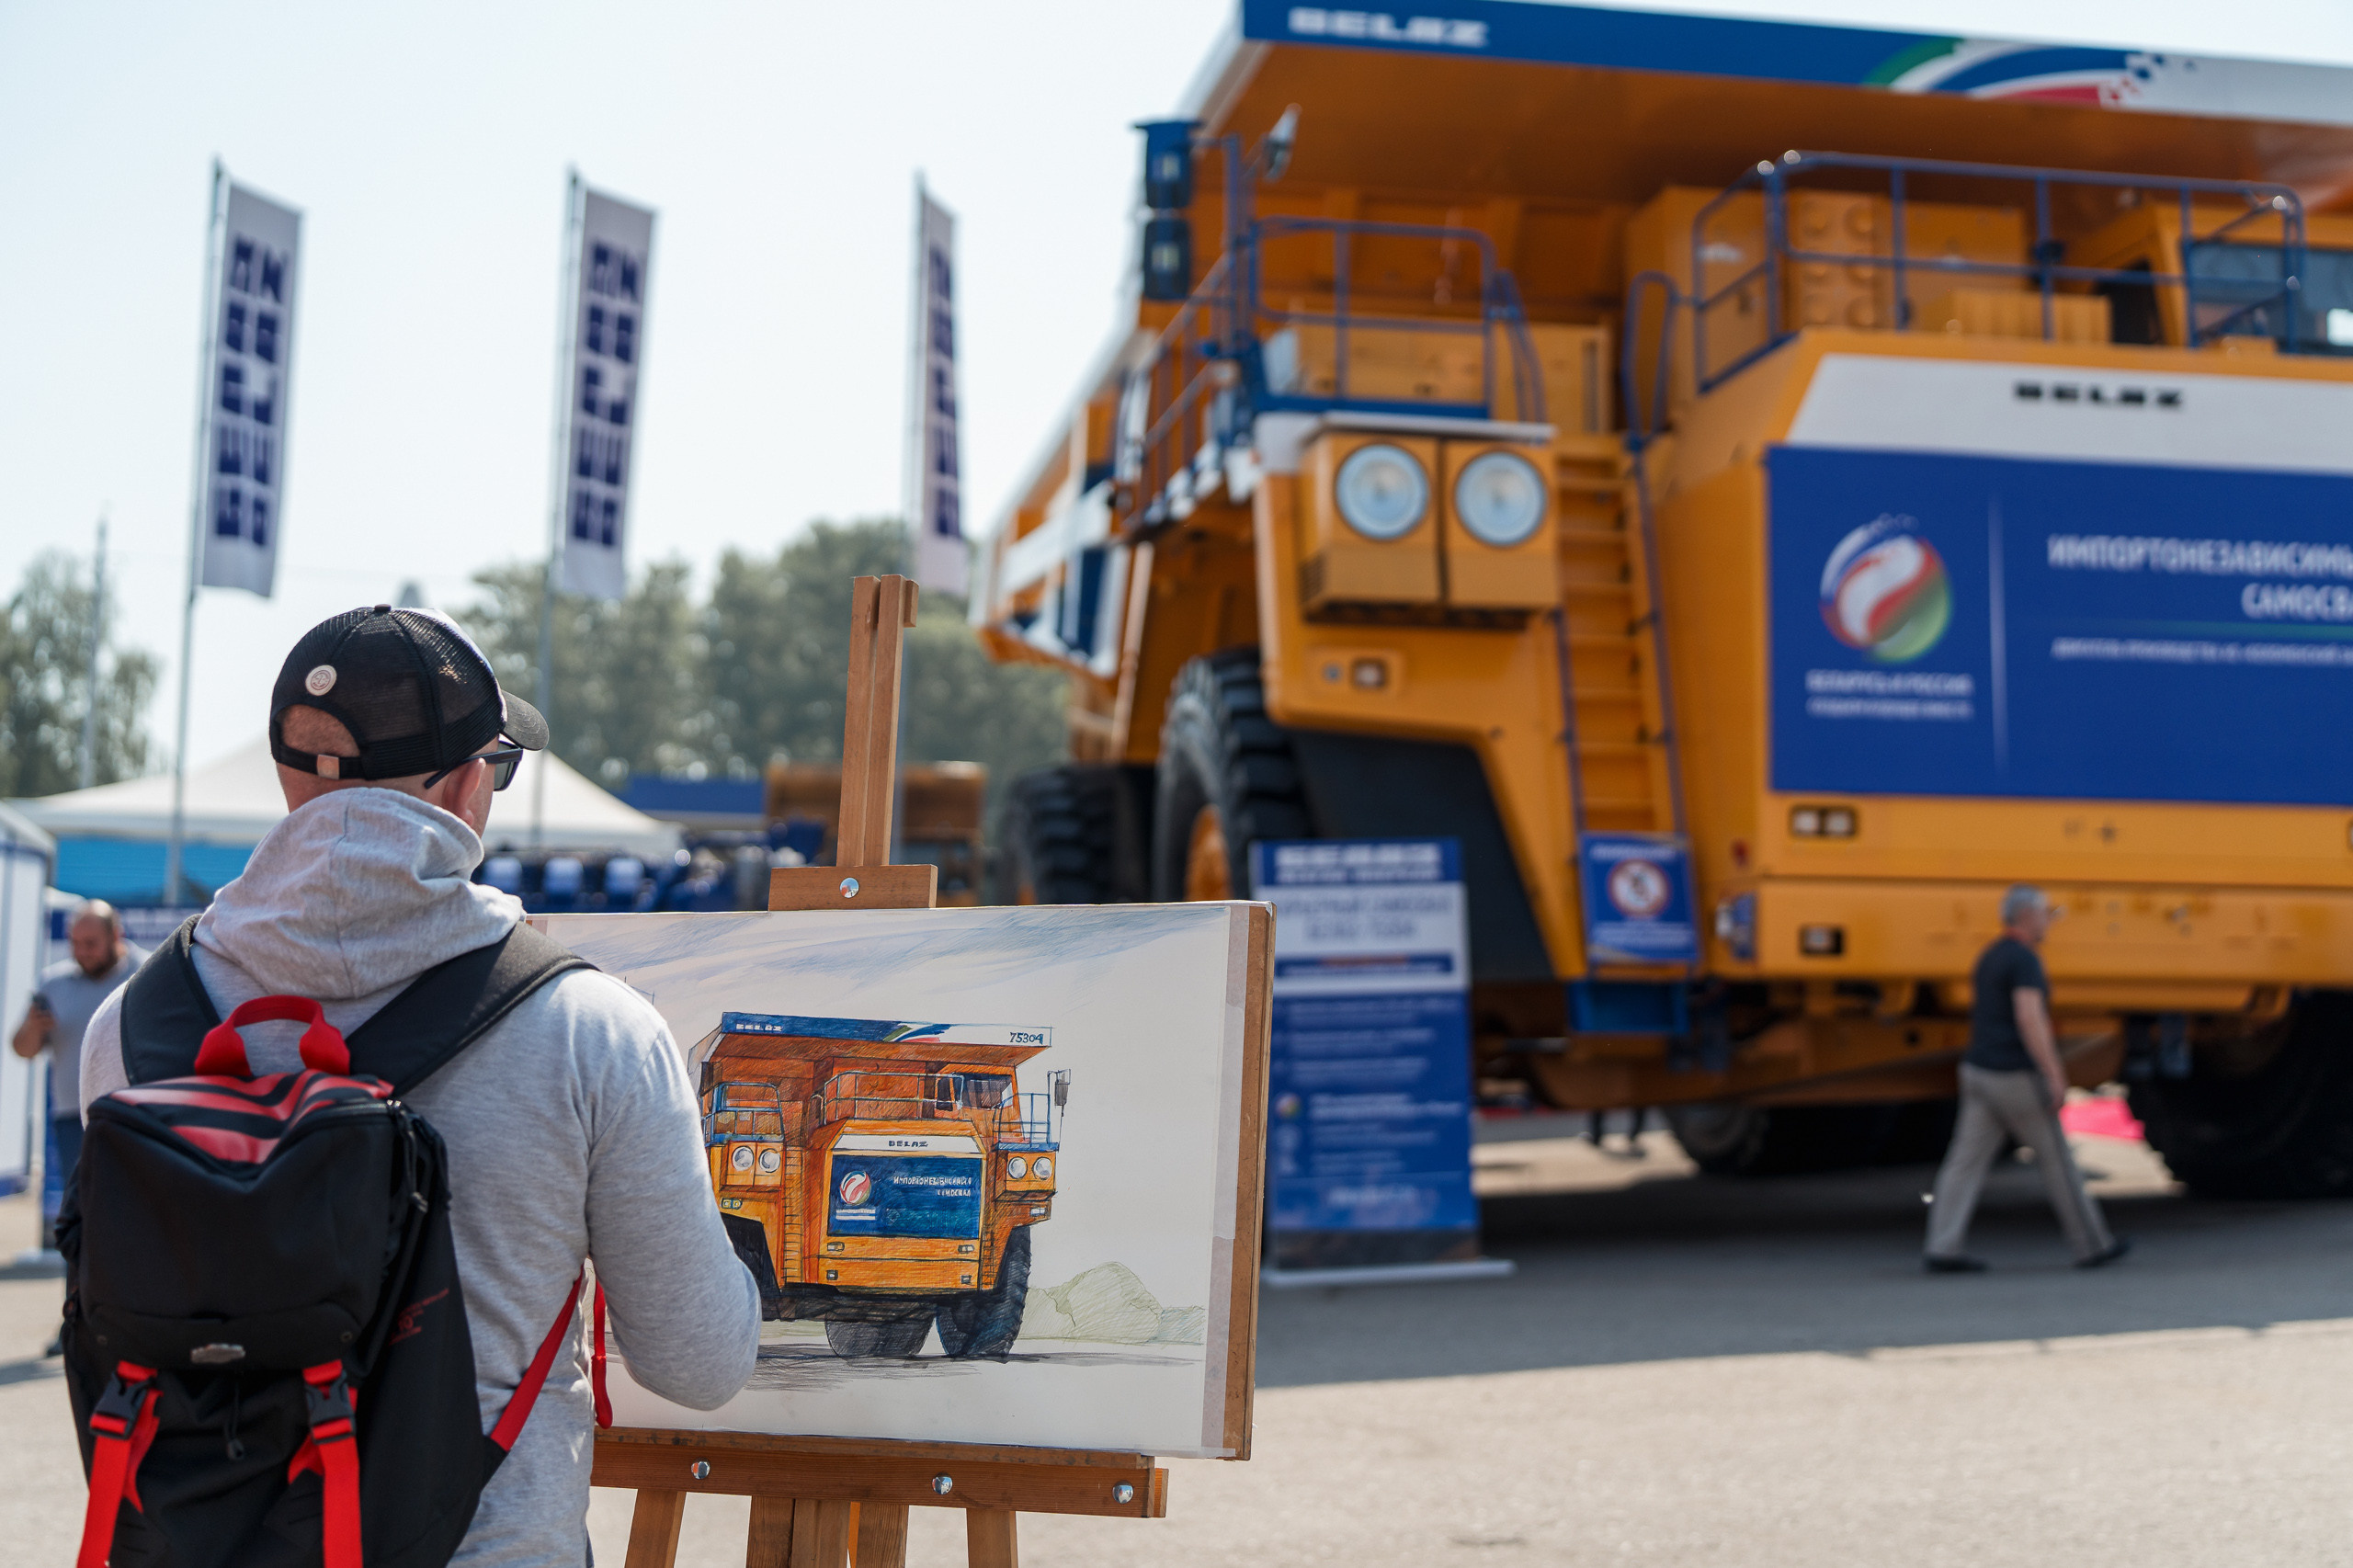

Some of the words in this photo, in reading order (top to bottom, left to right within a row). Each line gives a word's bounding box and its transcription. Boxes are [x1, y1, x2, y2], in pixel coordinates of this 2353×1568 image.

[1288, 6, 1489, 47] BELAZ
[2015, 382, 2185, 409] BELAZ
[1009, 1031, 1044, 1045] 75304
[888, 1140, 928, 1148] BELAZ
